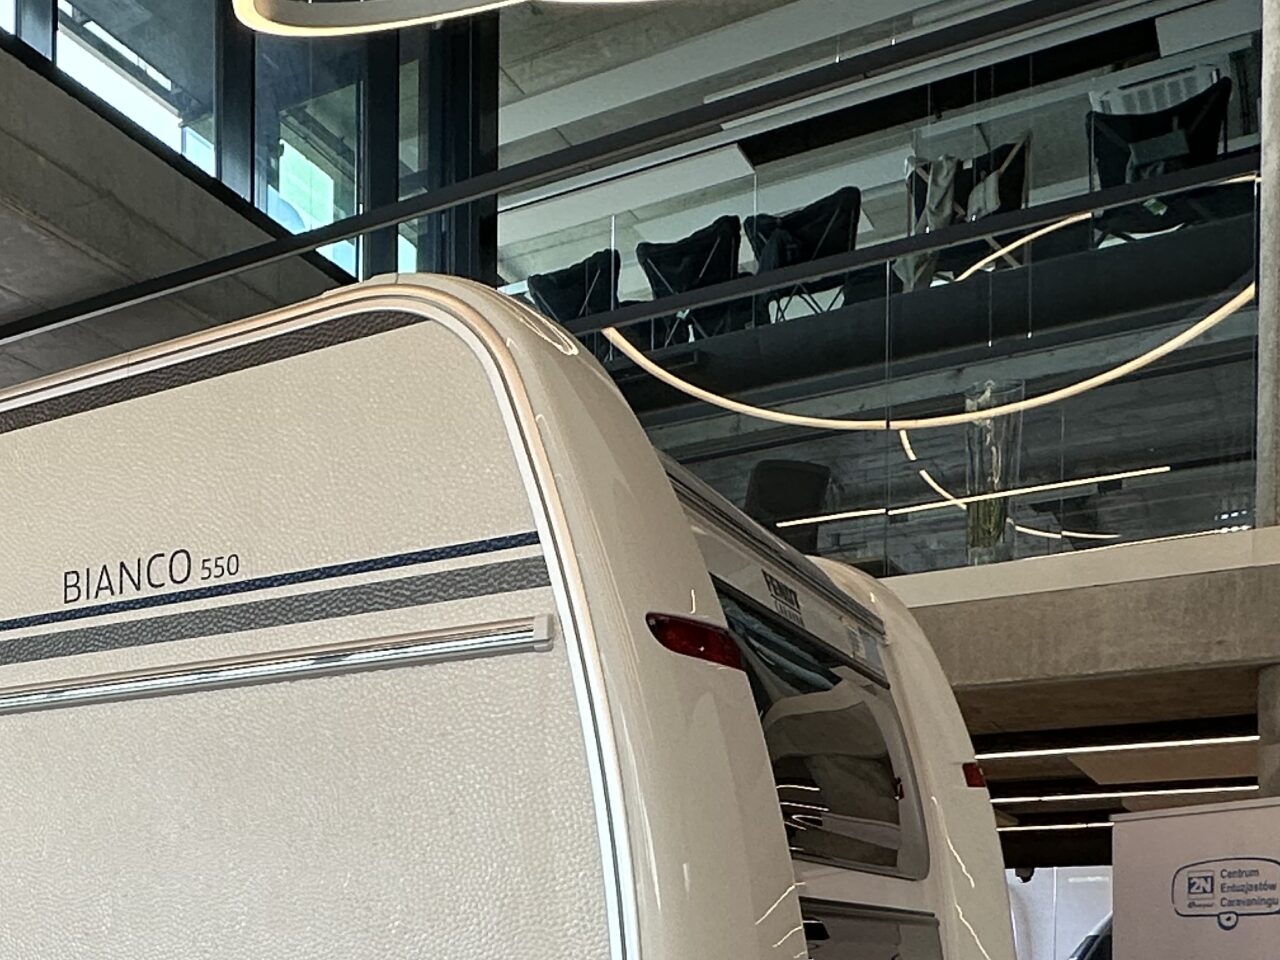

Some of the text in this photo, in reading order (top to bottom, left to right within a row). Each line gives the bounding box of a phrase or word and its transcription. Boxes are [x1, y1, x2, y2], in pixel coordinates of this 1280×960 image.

[63, 548, 240, 604] BIANCO 550
[1220, 868, 1259, 879] Centrum
[1190, 877, 1212, 893] 2N
[1220, 896, 1279, 908] Caravaningu
